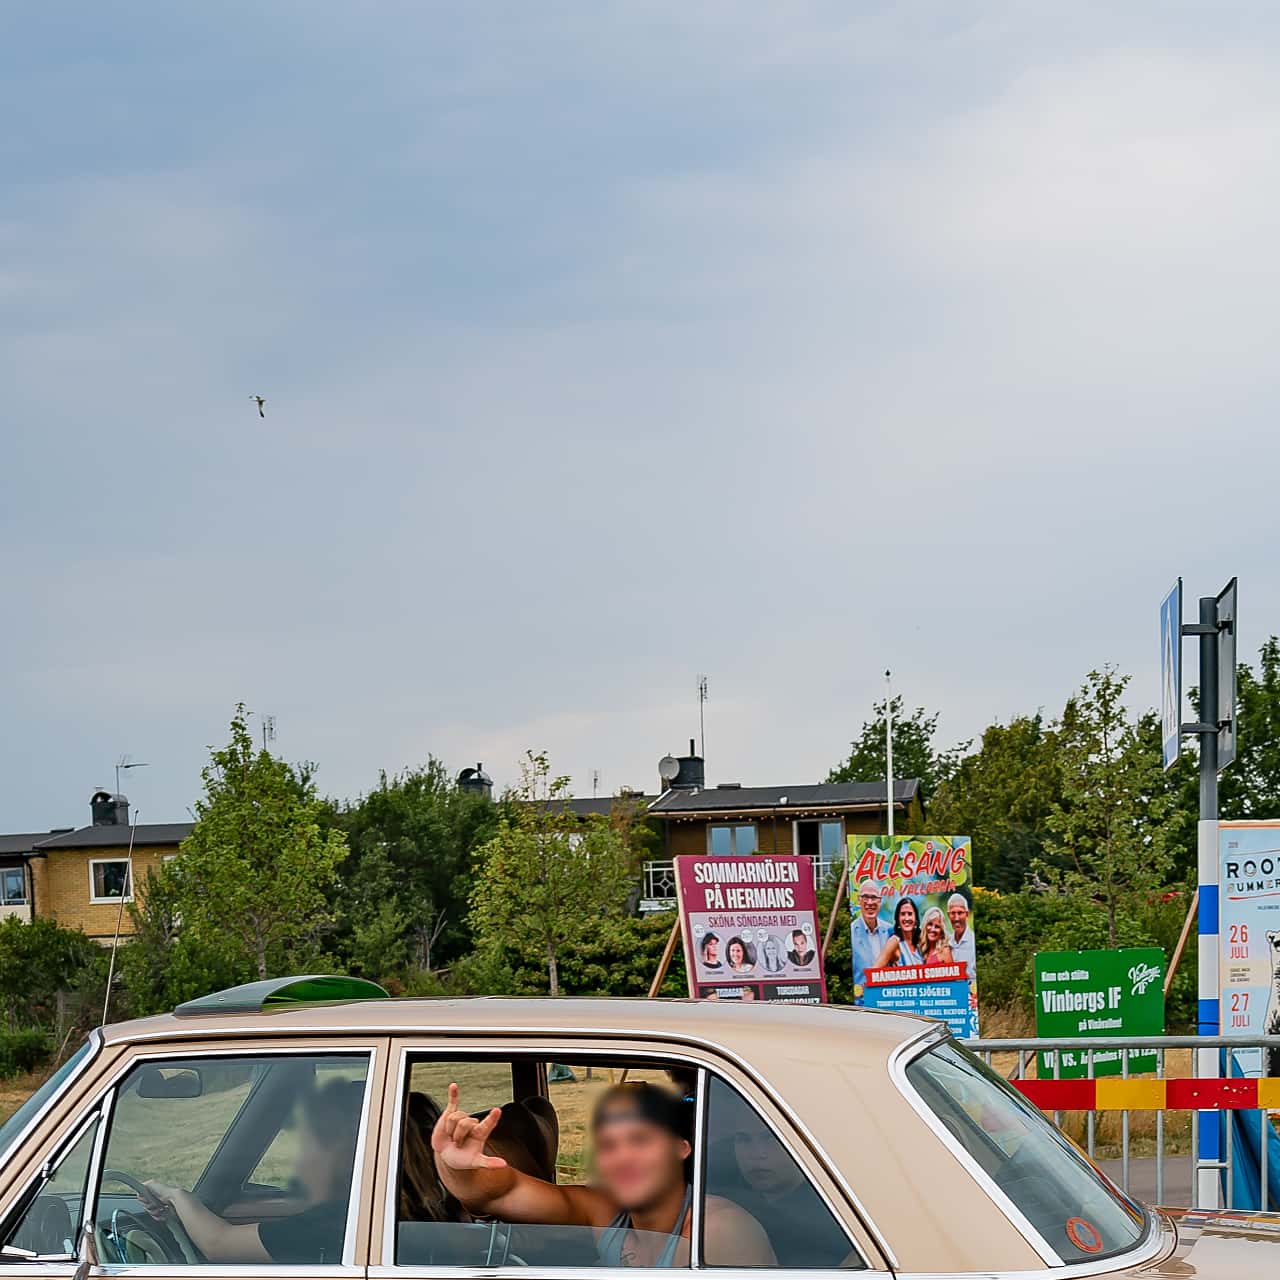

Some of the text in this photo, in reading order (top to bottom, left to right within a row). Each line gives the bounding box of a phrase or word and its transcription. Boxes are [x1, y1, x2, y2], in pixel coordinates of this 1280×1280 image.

[855, 841, 966, 882] ALLSÅNG
[693, 859, 799, 884] SOMMARNÖJEN
[704, 884, 795, 909] PÅ HERMANS
[880, 879, 957, 896] PÅ VALLARNA
[708, 915, 797, 928] SKÖNA SÖNDAGAR MED
[1229, 924, 1249, 943] 26
[1230, 946, 1249, 959] JULI
[871, 970, 918, 983] MÅNDAGAR
[924, 966, 960, 979] SOMMAR
[881, 986, 952, 998] CHRISTER SJÖGREN
[1042, 986, 1122, 1013] Vinbergs IF
[1231, 993, 1249, 1012] 27
[1231, 1014, 1250, 1028] JULI
